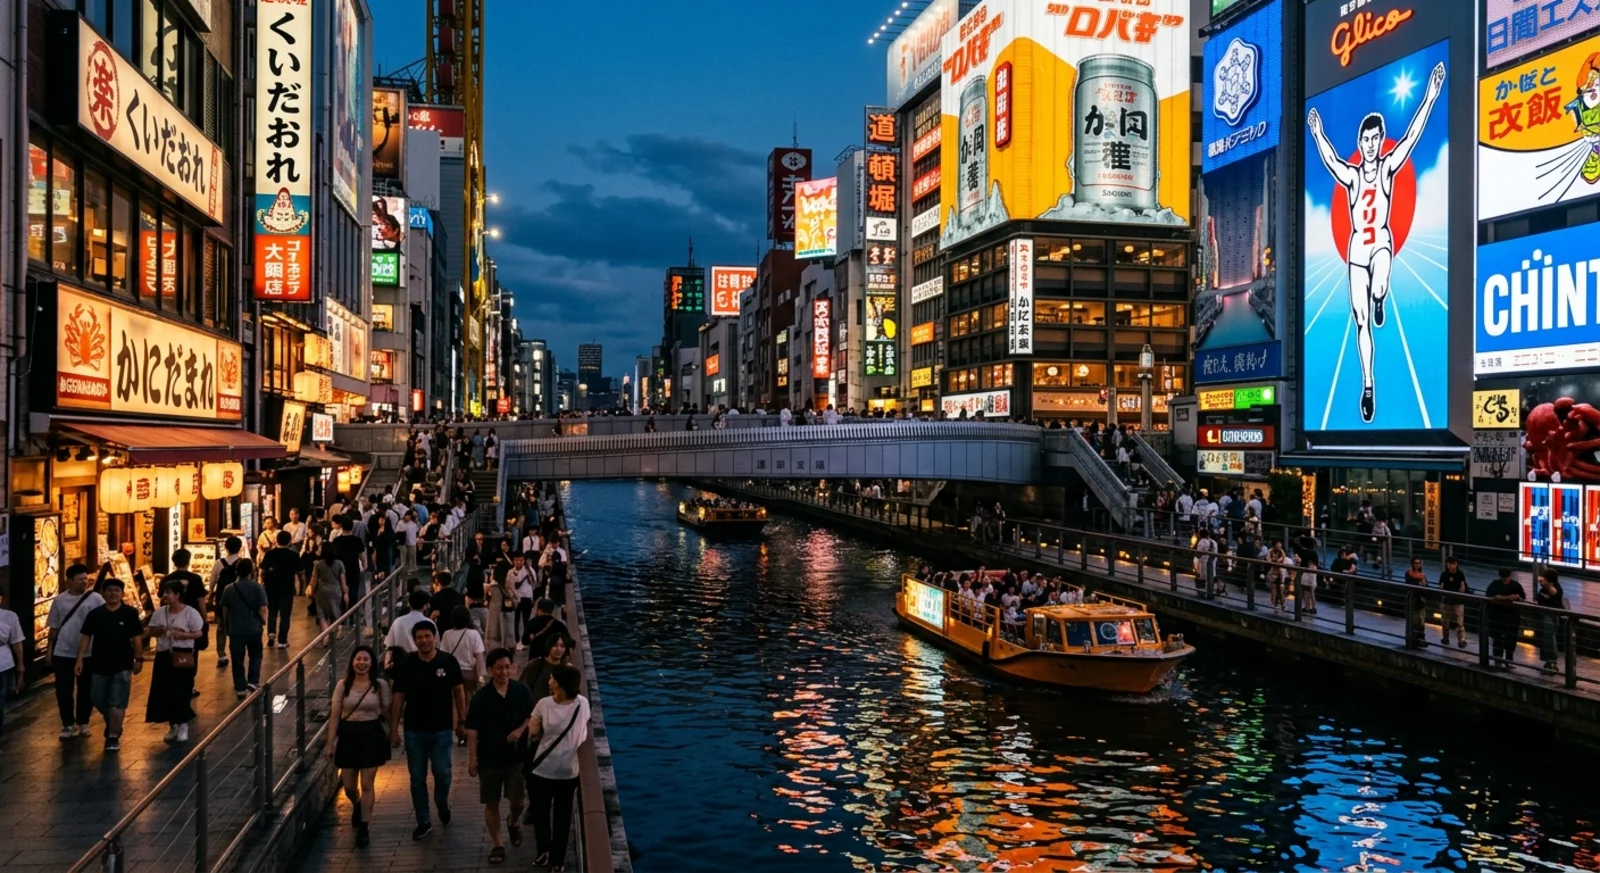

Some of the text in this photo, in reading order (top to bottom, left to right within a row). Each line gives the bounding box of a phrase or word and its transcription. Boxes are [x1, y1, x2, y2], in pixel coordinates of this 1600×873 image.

[126, 88, 205, 195] くいだおれ
[267, 12, 302, 184] くいだおれ
[868, 113, 896, 212] 道頓堀
[1362, 183, 1376, 246] グリコ
[117, 329, 214, 411] かにだまれ
